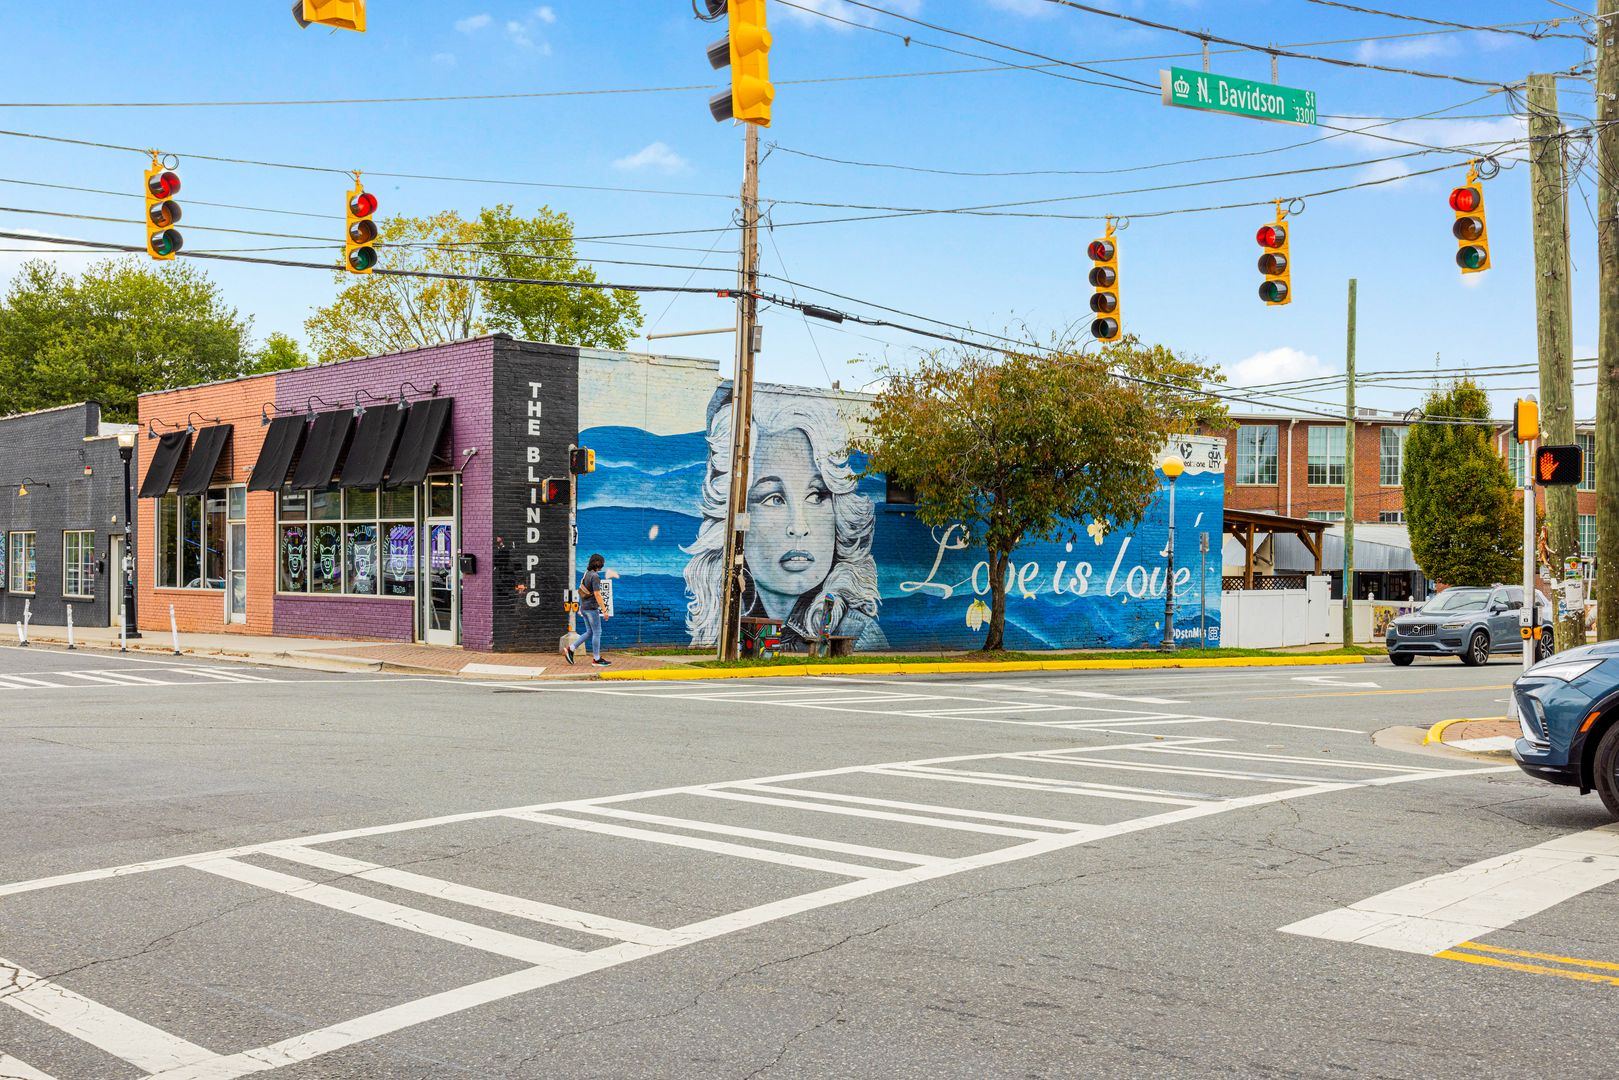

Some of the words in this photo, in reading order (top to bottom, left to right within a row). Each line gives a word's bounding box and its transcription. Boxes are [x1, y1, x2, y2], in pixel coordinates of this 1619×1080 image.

[1197, 77, 1212, 104] N.
[1219, 80, 1285, 115] Davidson
[1295, 107, 1315, 124] 3300
[1305, 91, 1315, 108] St
[527, 381, 542, 436] THE
[526, 446, 541, 544] BLIND
[354, 525, 372, 538] BLIND
[525, 554, 541, 608] PIG
[1053, 543, 1092, 595] is
[1105, 537, 1196, 597] love
